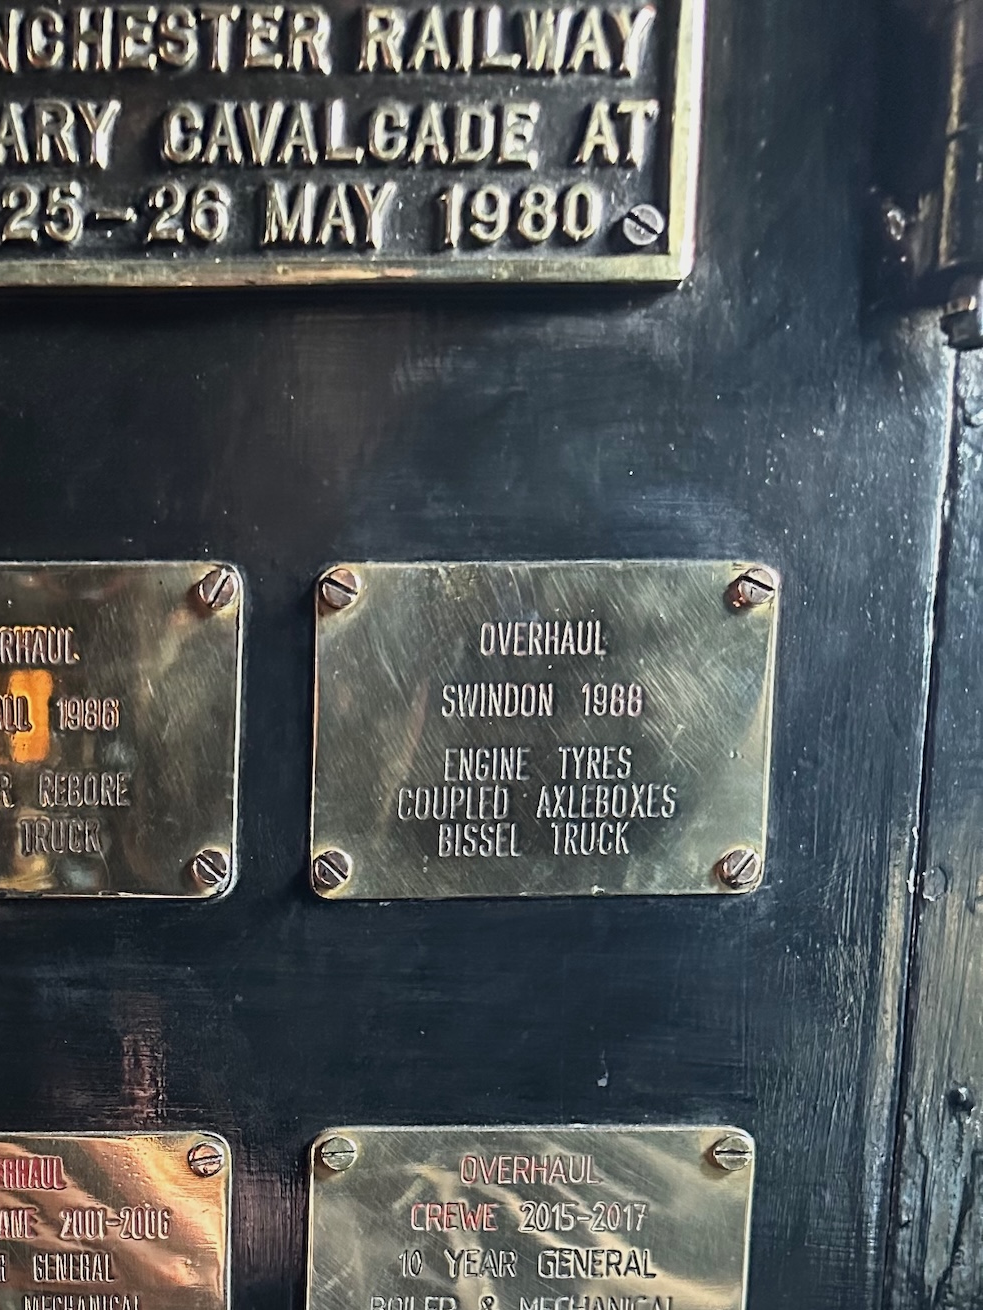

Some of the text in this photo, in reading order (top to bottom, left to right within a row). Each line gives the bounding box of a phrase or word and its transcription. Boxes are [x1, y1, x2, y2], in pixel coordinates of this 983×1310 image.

[358, 4, 656, 78] RAILWAY
[163, 101, 540, 170] CAVALCADE
[575, 99, 659, 166] AT
[263, 182, 398, 249] MAY
[438, 183, 604, 249] 1980
[480, 620, 606, 656] OVERHAUL
[57, 698, 120, 731] 1986
[441, 683, 643, 717] SWINDON 1988
[444, 746, 632, 781] ENGINE TYRES
[39, 770, 130, 807] REBORE
[397, 784, 677, 820] COUPLED AXLEBOXES
[20, 817, 102, 854] TRUCK
[438, 822, 630, 857] BISSEL TRUCK
[459, 1155, 602, 1186] OVERHAUL
[59, 1207, 172, 1240] 2001-2006
[410, 1201, 649, 1231] CREWE 2015-2017
[33, 1253, 115, 1282] GENERAL
[398, 1249, 656, 1279] 10 YEAR GENERAL
